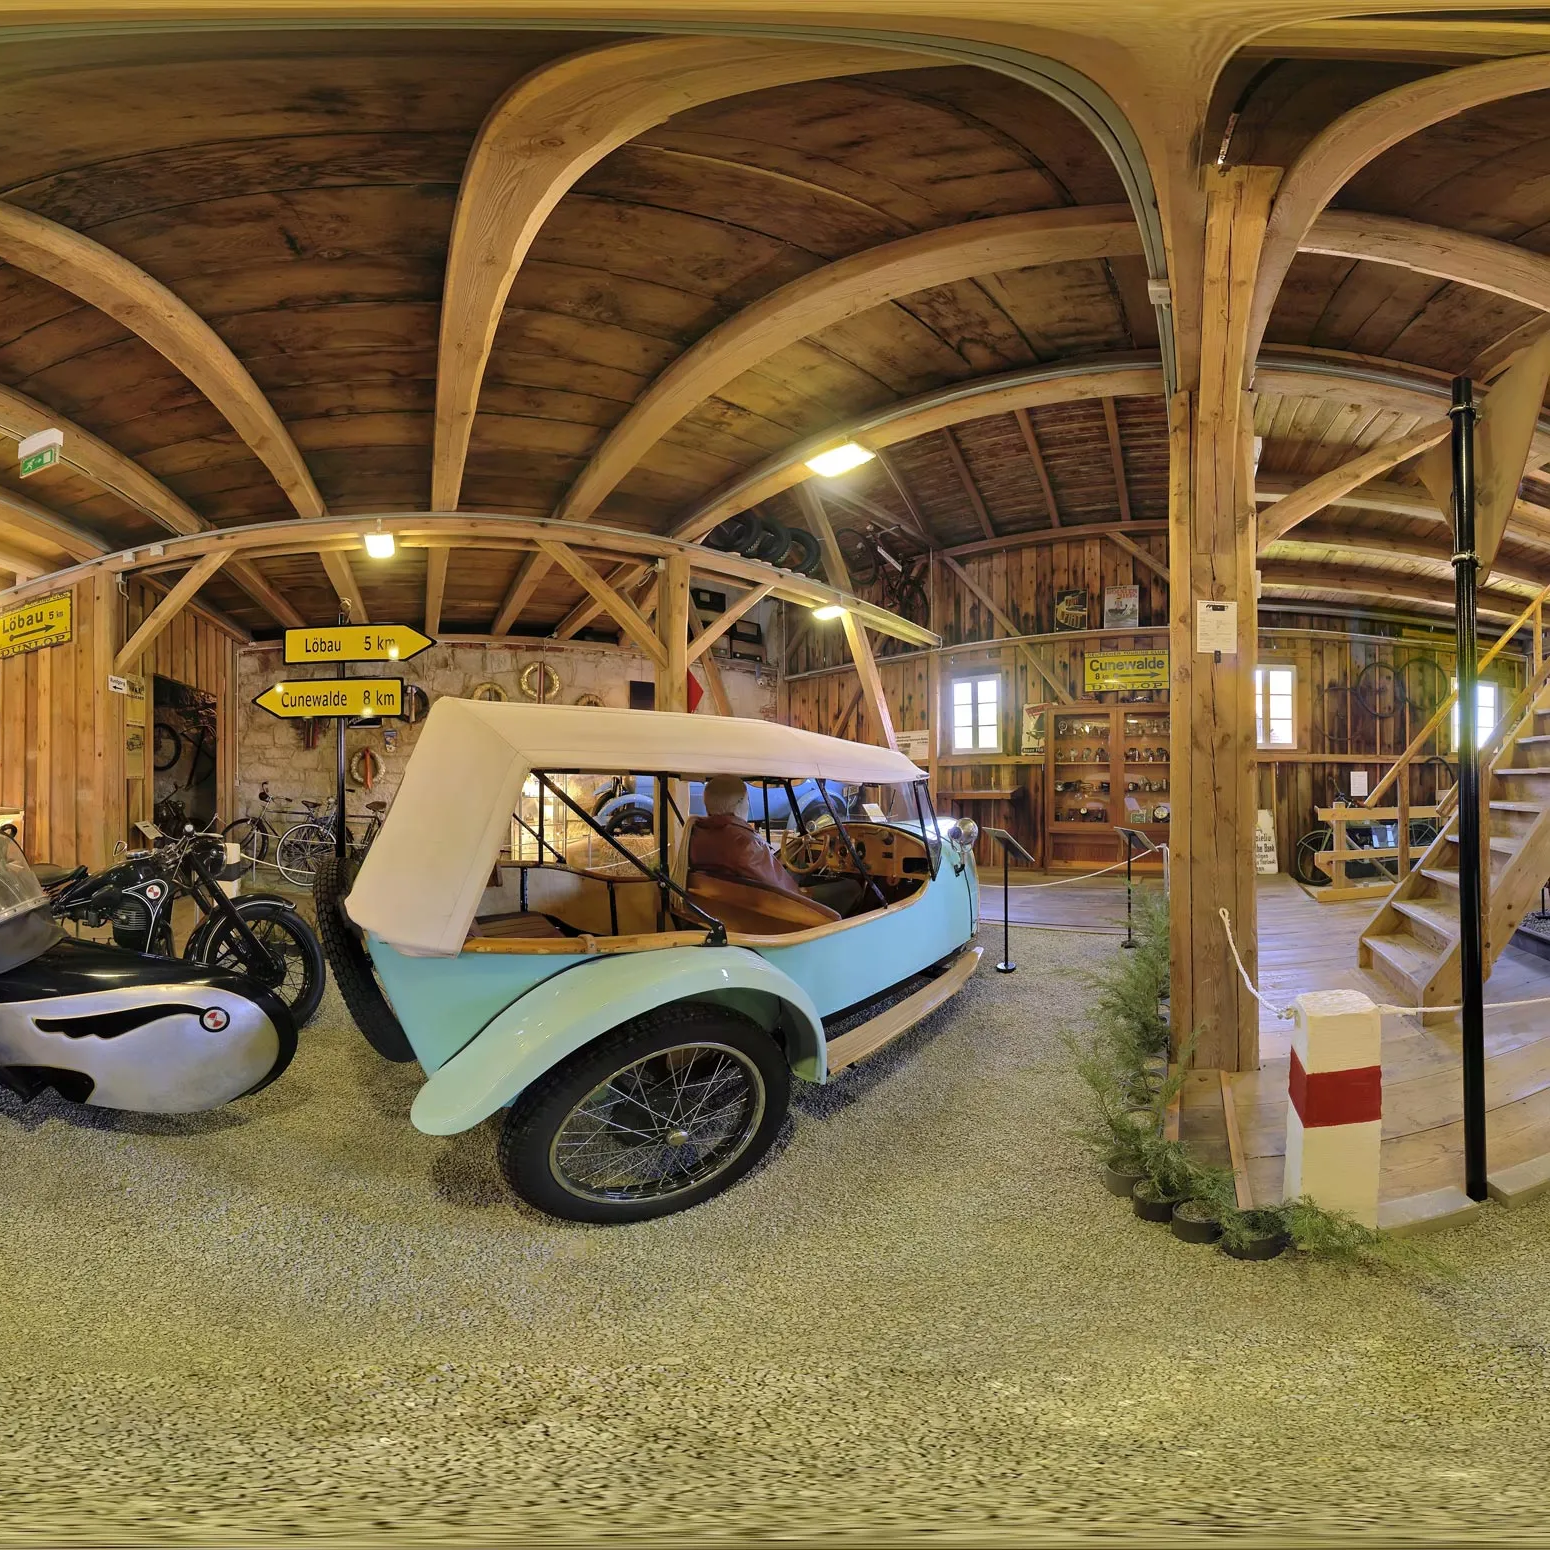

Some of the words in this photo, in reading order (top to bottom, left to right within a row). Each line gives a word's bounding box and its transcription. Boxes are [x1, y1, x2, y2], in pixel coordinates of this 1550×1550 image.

[2, 610, 44, 634] Löbau
[48, 610, 55, 620] 5
[0, 633, 66, 657] DUNLOP
[305, 637, 341, 653] Löbau
[364, 636, 372, 650] 5
[377, 635, 396, 650] km
[1090, 657, 1165, 672] Cunewalde
[1092, 682, 1163, 691] DUNLOP
[281, 691, 347, 708] Cunewalde
[363, 690, 371, 705] 8
[376, 690, 395, 706] km
